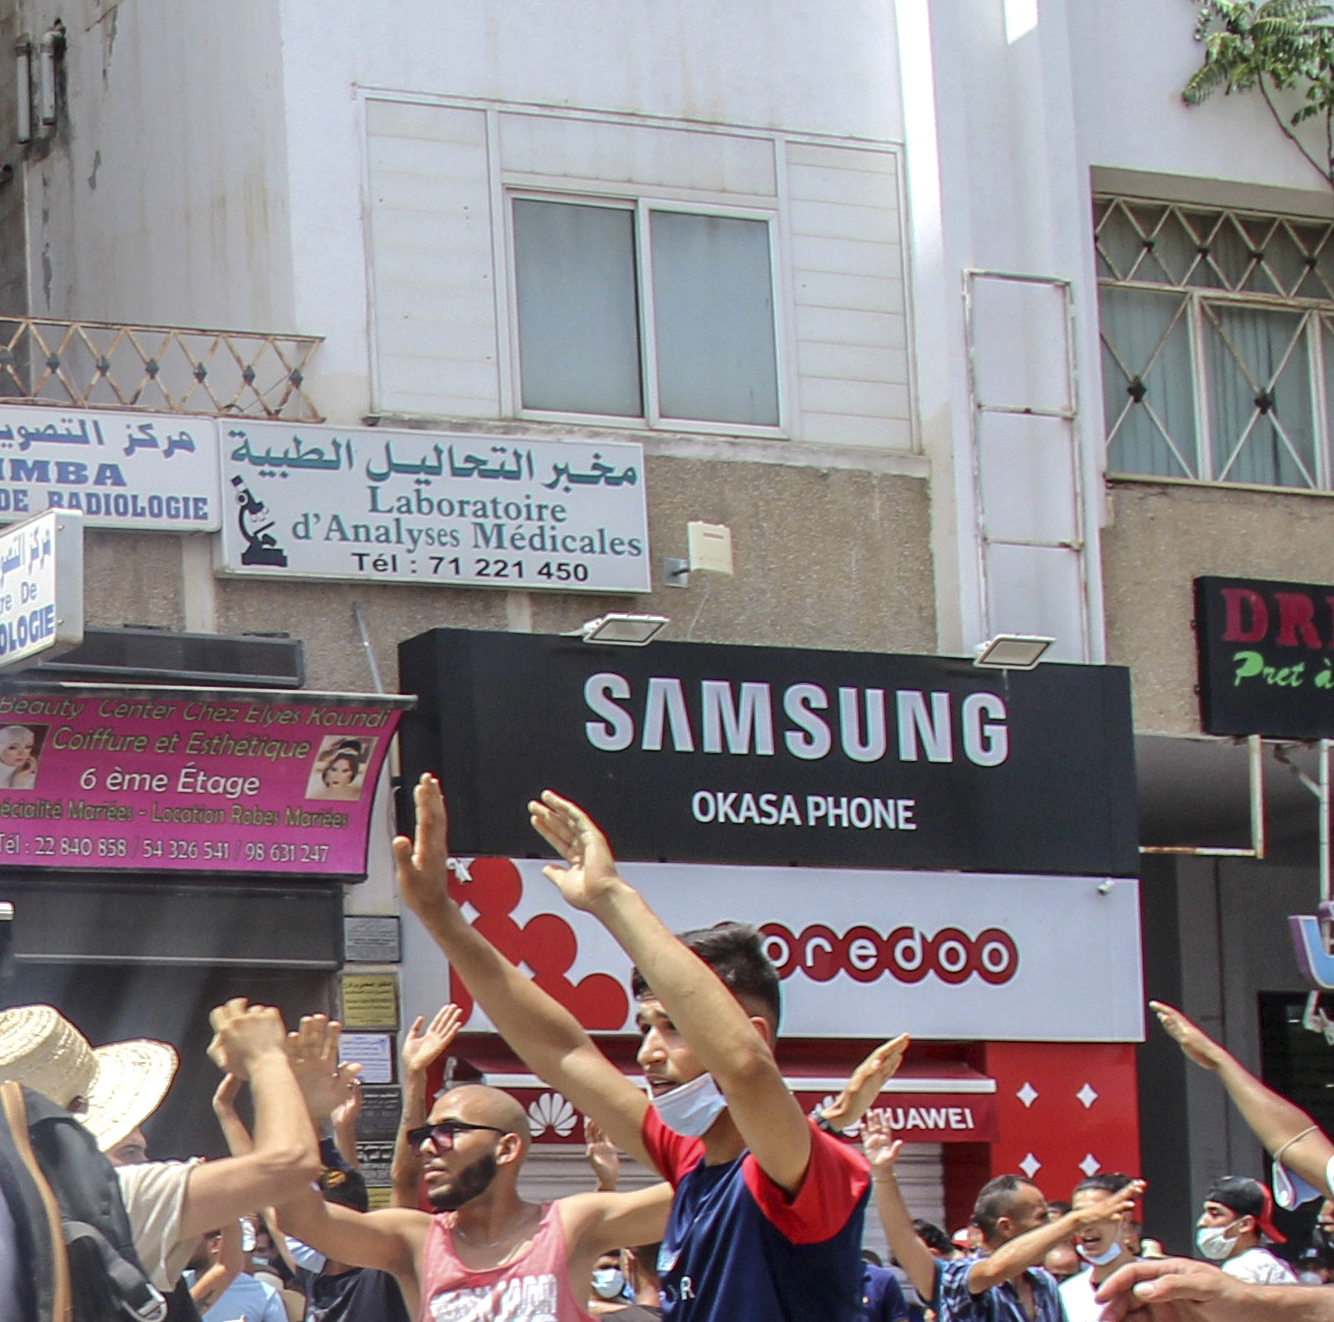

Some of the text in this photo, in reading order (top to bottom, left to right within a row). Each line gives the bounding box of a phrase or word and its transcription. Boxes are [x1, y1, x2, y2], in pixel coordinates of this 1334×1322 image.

[123, 423, 196, 459] مركز
[227, 429, 639, 493] مخبر التحاليل الطبية
[47, 490, 209, 521] RADIOLOGIE
[367, 485, 567, 523] Laboratoire
[292, 512, 643, 558] d'Analyses Médicales
[351, 551, 398, 574] Tél
[428, 556, 461, 576] 71
[475, 558, 525, 579] 221
[537, 560, 590, 582] 450
[21, 581, 37, 605] De
[1221, 588, 1334, 649] DR
[1233, 650, 1305, 687] Pret
[98, 699, 177, 720] Center
[183, 702, 240, 723] Chez
[244, 704, 302, 728] Elyes
[583, 672, 1009, 768] SAMSUNG
[52, 726, 311, 763] Coiffure et Esthétique
[79, 761, 261, 798] 6 ème Étage
[68, 800, 134, 823] Mariées
[151, 803, 225, 824] Location
[232, 804, 280, 827] Robes
[284, 807, 350, 829] Mariées
[691, 789, 918, 831] OKASA PHONE
[34, 836, 56, 856] 22
[60, 838, 93, 857] 840
[97, 838, 127, 858] 858
[142, 840, 164, 859] 54
[167, 841, 198, 860] 326
[203, 842, 230, 860] 541
[245, 843, 266, 863] 98
[270, 844, 297, 863] 631
[300, 845, 330, 864] 247
[760, 925, 1011, 974] oredoo
